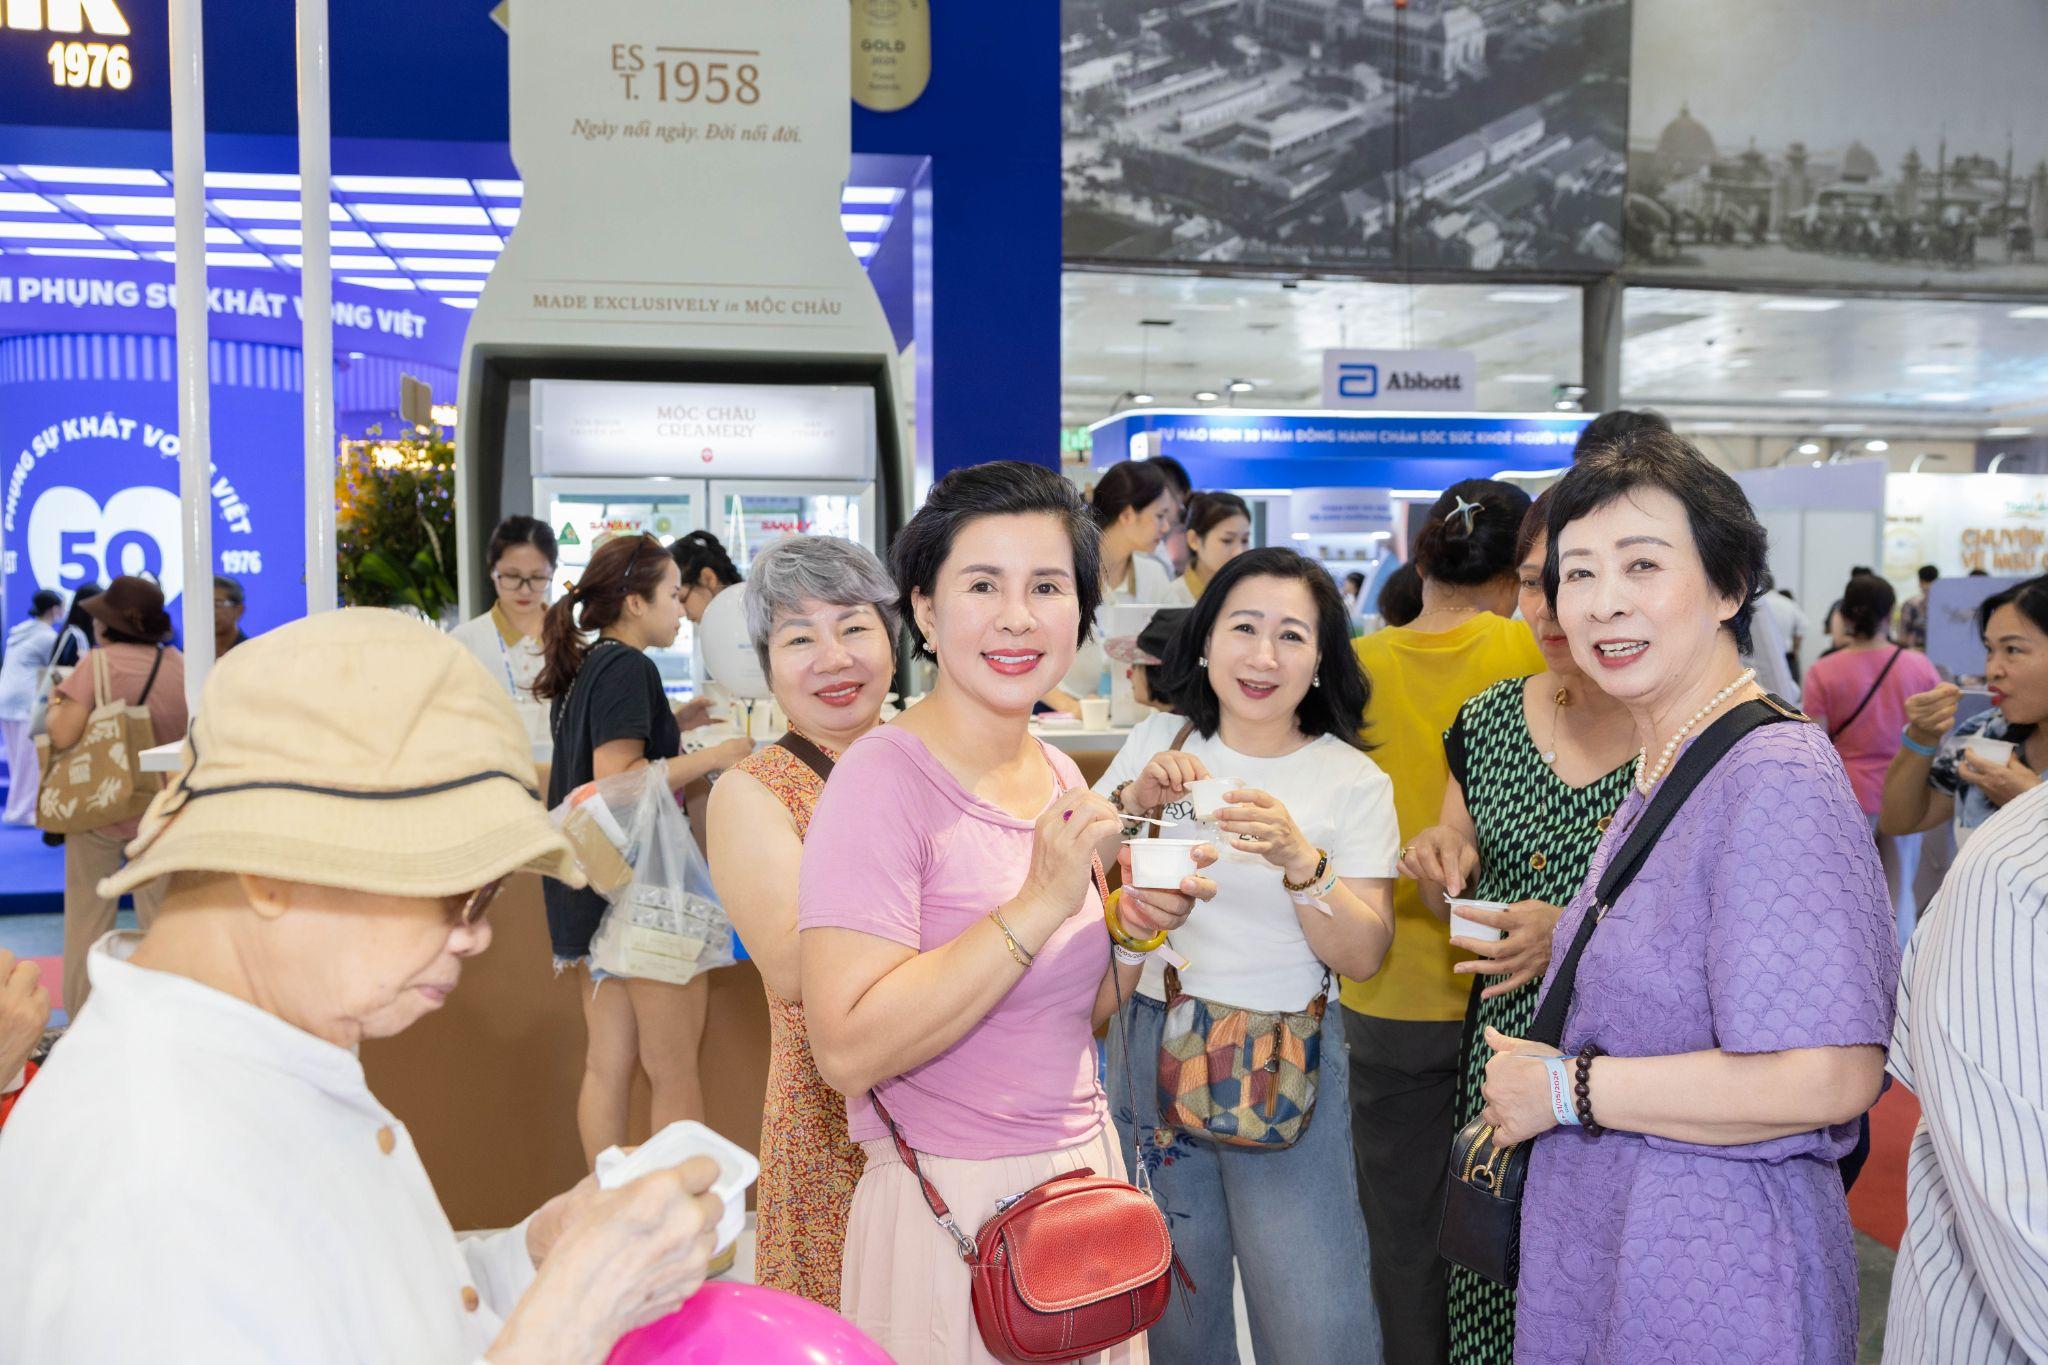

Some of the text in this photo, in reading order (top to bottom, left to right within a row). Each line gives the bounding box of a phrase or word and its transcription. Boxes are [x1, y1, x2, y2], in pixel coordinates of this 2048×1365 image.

[860, 39, 906, 53] GOLD
[47, 40, 133, 90] 1976
[653, 60, 761, 105] 1958
[571, 118, 617, 141] Ngày
[18, 277, 140, 309] PHỤNG
[376, 307, 427, 340] VIỆT
[533, 294, 587, 310] MADE
[593, 296, 720, 313] EXCLUSIVELY
[724, 300, 739, 312] in
[745, 298, 786, 315] MỘC
[1386, 372, 1462, 391] Abbott
[657, 423, 755, 438] CREAMERY
[211, 476, 252, 534] VIỆT
[59, 530, 162, 592] 50
[221, 549, 262, 574] 1976
